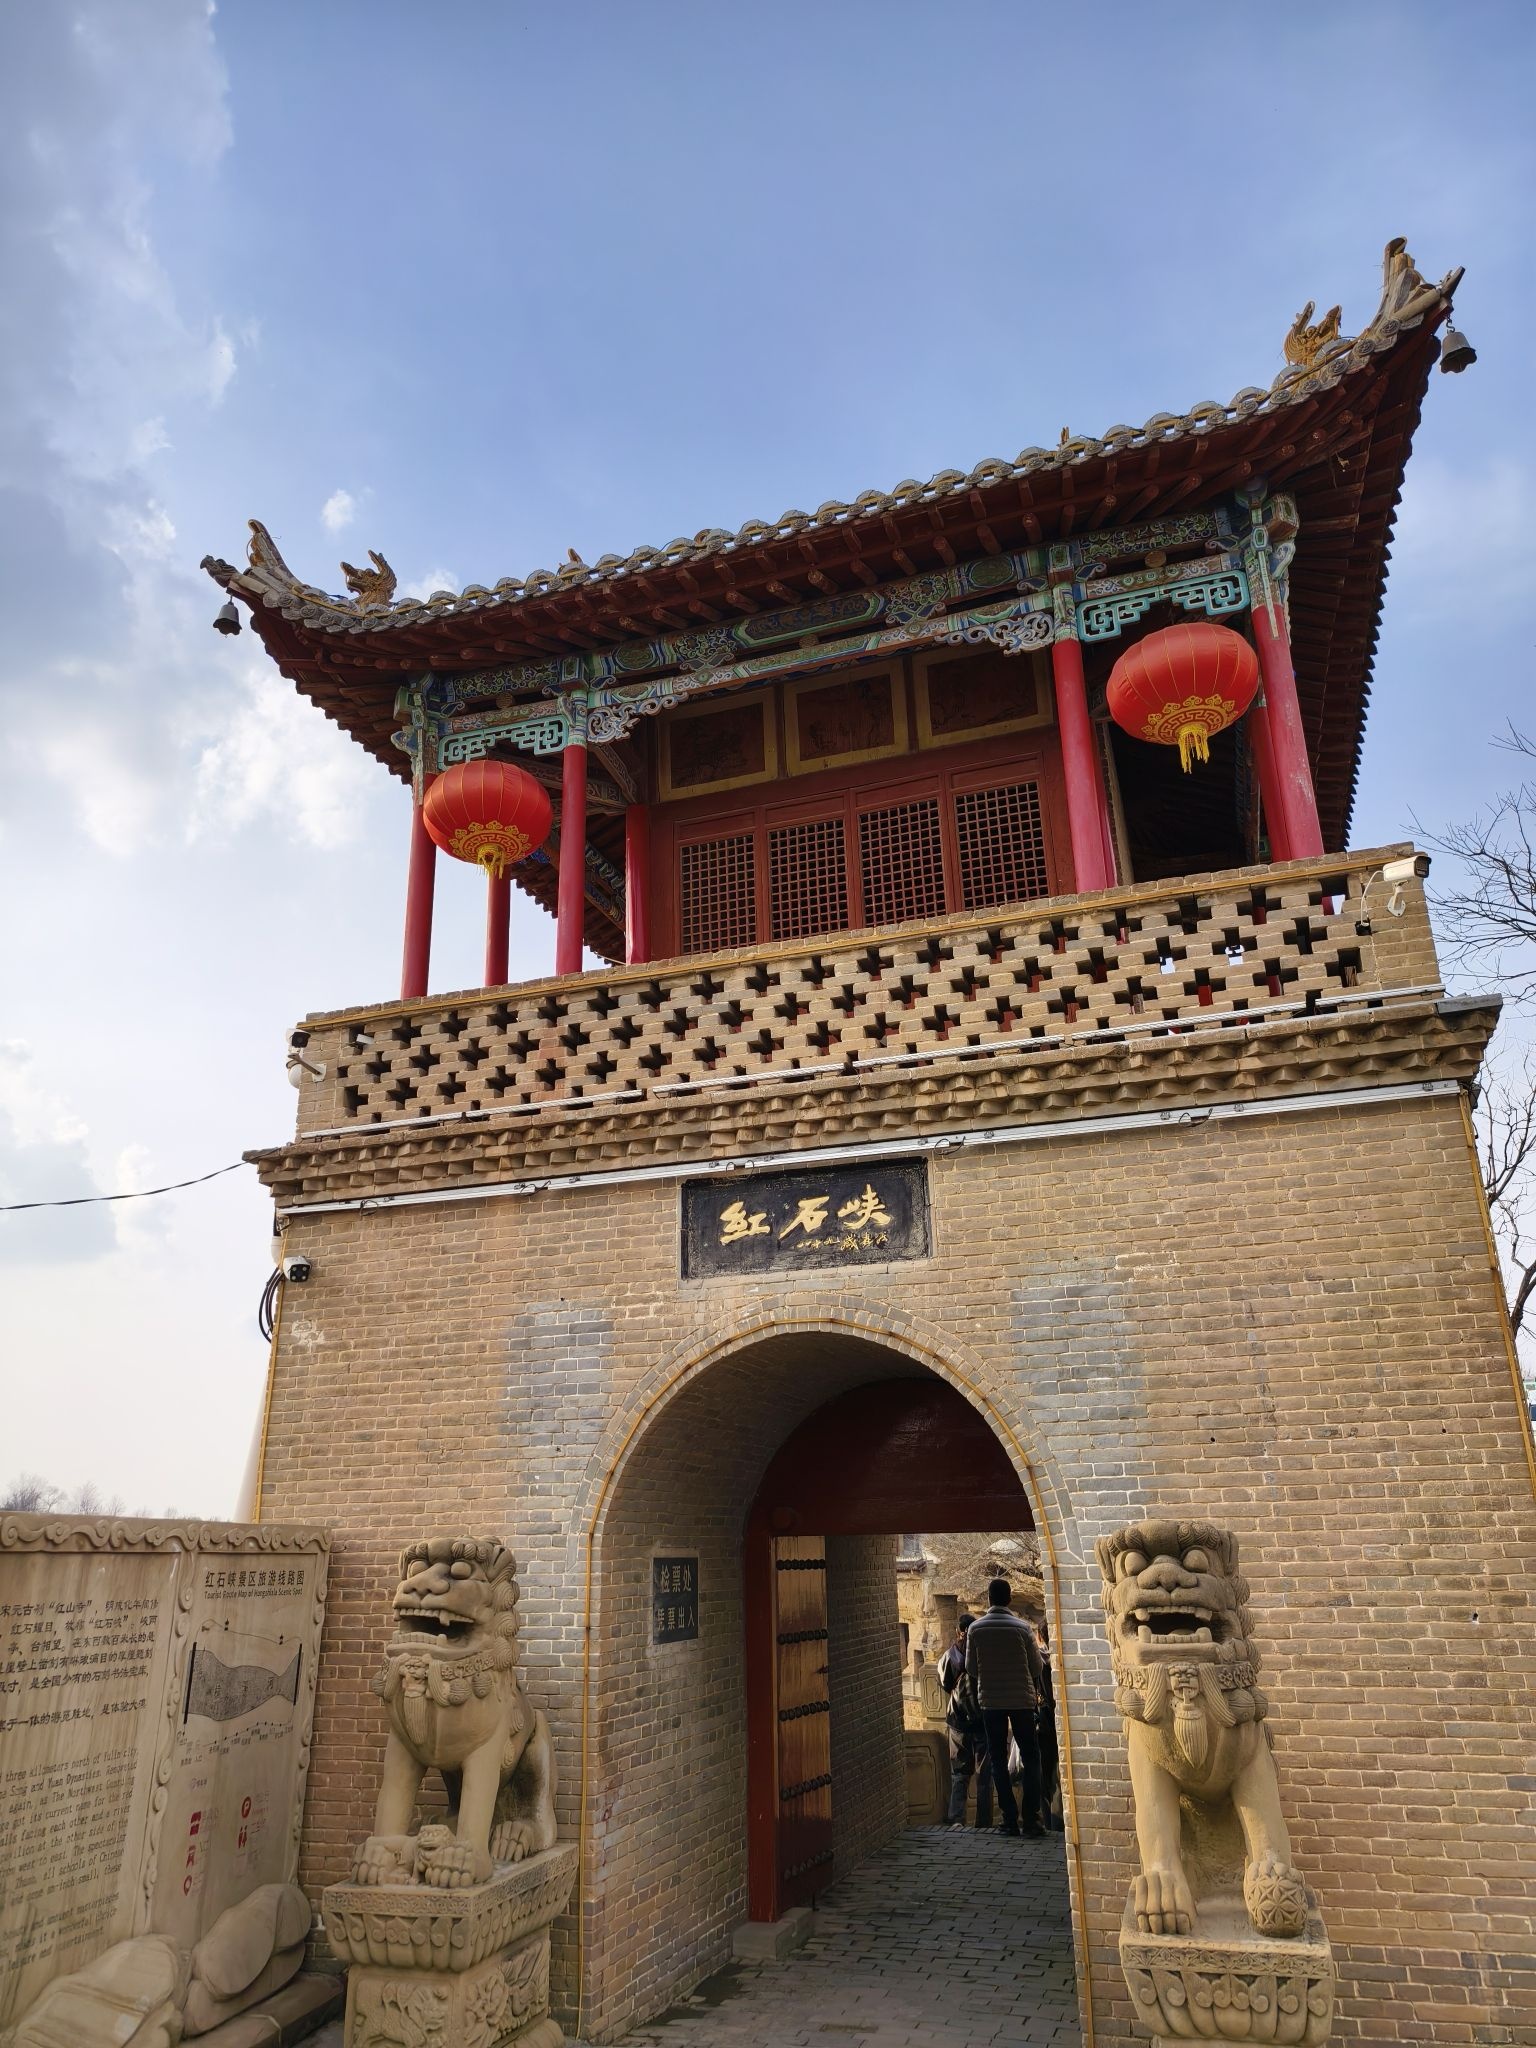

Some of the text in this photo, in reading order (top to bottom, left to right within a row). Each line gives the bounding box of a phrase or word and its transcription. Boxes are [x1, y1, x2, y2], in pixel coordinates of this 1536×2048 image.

[720, 1184, 891, 1246] 红石峡
[204, 1570, 305, 1587] 红石峡景区旅游线路图
[204, 1590, 222, 1599] Tourist
[222, 1590, 237, 1598] Route
[237, 1589, 248, 1598] Map
[278, 1587, 292, 1596] Scenic
[292, 1587, 303, 1596] Spot
[660, 1564, 691, 1593] 检票处
[657, 1605, 694, 1631] 凭票出入
[6, 1769, 26, 1782] three
[29, 1763, 69, 1777] kilometers
[72, 1755, 90, 1769] north
[93, 1753, 102, 1764] of
[10, 1784, 28, 1797] Song
[30, 1778, 44, 1793] and
[48, 1777, 64, 1789] Yuan
[40, 1796, 48, 1806] as
[52, 1791, 65, 1803] The
[68, 1783, 103, 1799] Northwest
[12, 1816, 25, 1830] got
[30, 1812, 42, 1824] its
[45, 1805, 72, 1820] current
[76, 1801, 91, 1811] name
[95, 1795, 105, 1808] for
[108, 1791, 120, 1804] the
[122, 1787, 134, 1800] red
[21, 1827, 46, 1842] facing
[50, 1820, 66, 1833] each
[69, 1816, 88, 1828] other
[91, 1809, 104, 1821] and
[113, 1804, 130, 1816] river
[38, 1841, 46, 1852] at
[50, 1835, 62, 1848] the
[67, 1831, 86, 1843] other
[89, 1823, 104, 1837] side
[107, 1820, 116, 1832] of
[118, 1817, 128, 1831] the
[19, 1860, 35, 1872] west
[39, 1856, 48, 1866] to
[73, 1845, 85, 1857] The
[87, 1833, 126, 1853] spectacular
[43, 1867, 55, 1881] all
[58, 1858, 85, 1876] schools
[88, 1854, 97, 1866] of
[99, 1848, 124, 1863] Chinese
[104, 1863, 121, 1876] these
[39, 1932, 47, 1944] it
[58, 1915, 92, 1935] wonderful
